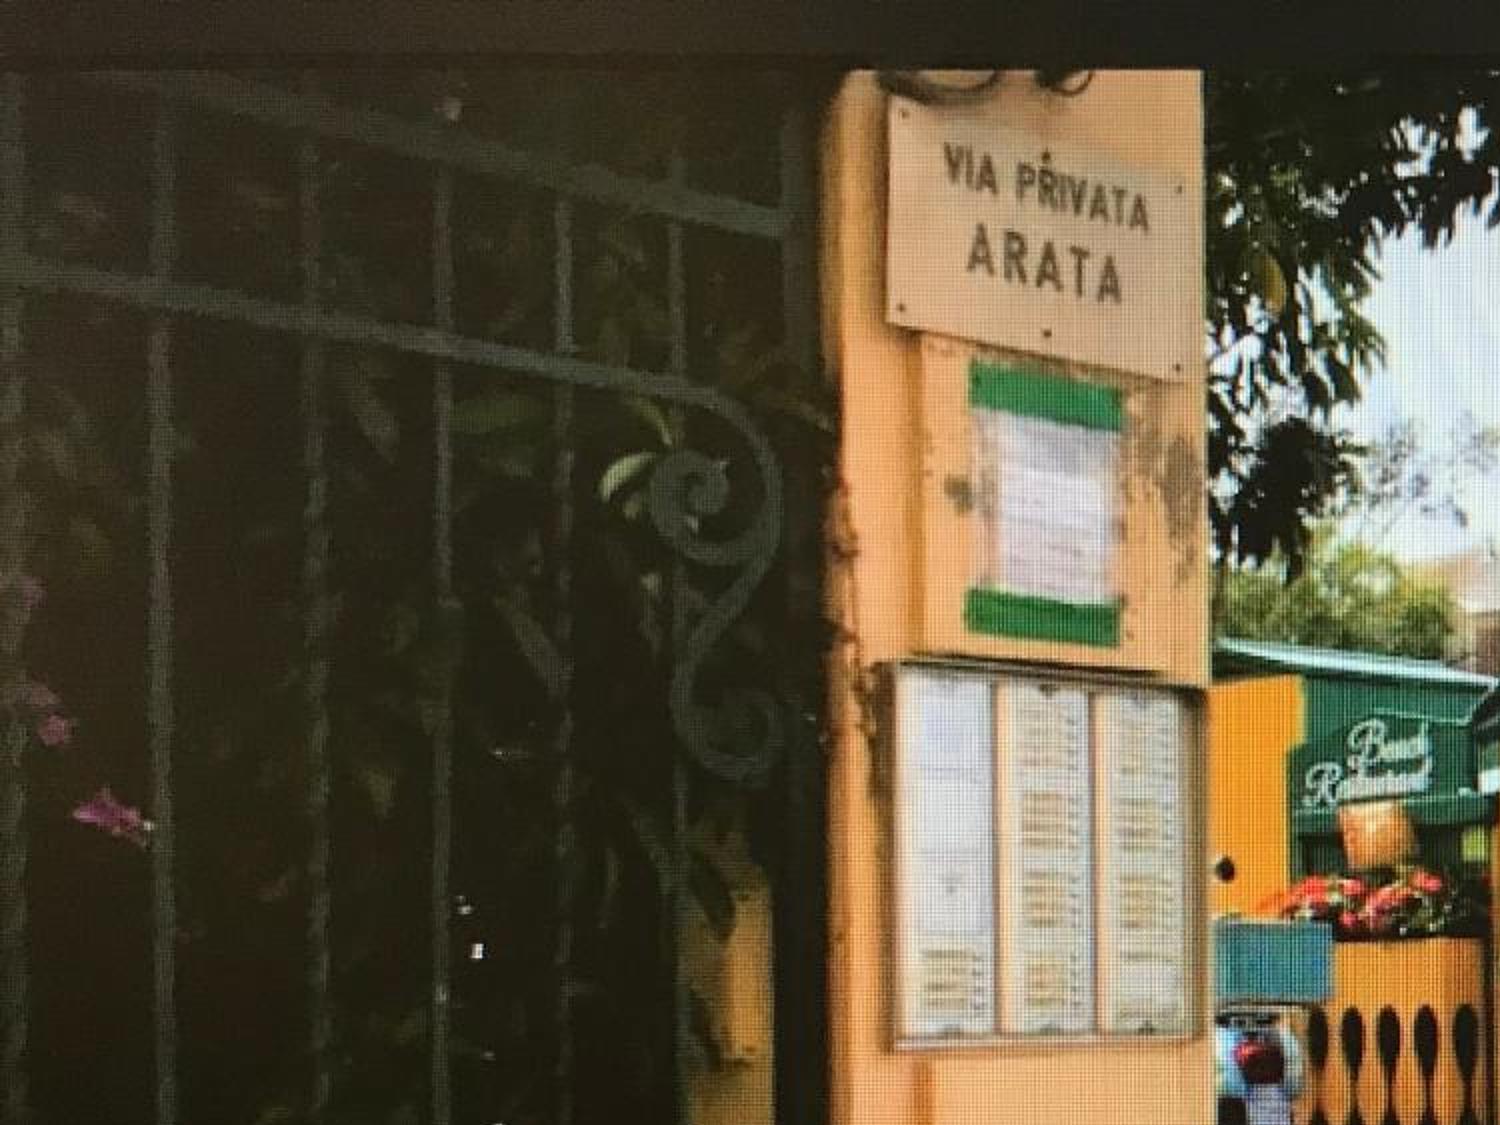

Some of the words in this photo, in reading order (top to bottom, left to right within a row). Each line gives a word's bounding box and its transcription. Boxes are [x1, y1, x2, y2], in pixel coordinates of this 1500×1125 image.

[943, 141, 999, 195] VIA
[1015, 160, 1149, 231] PRIVATA
[966, 222, 1123, 303] ARATA
